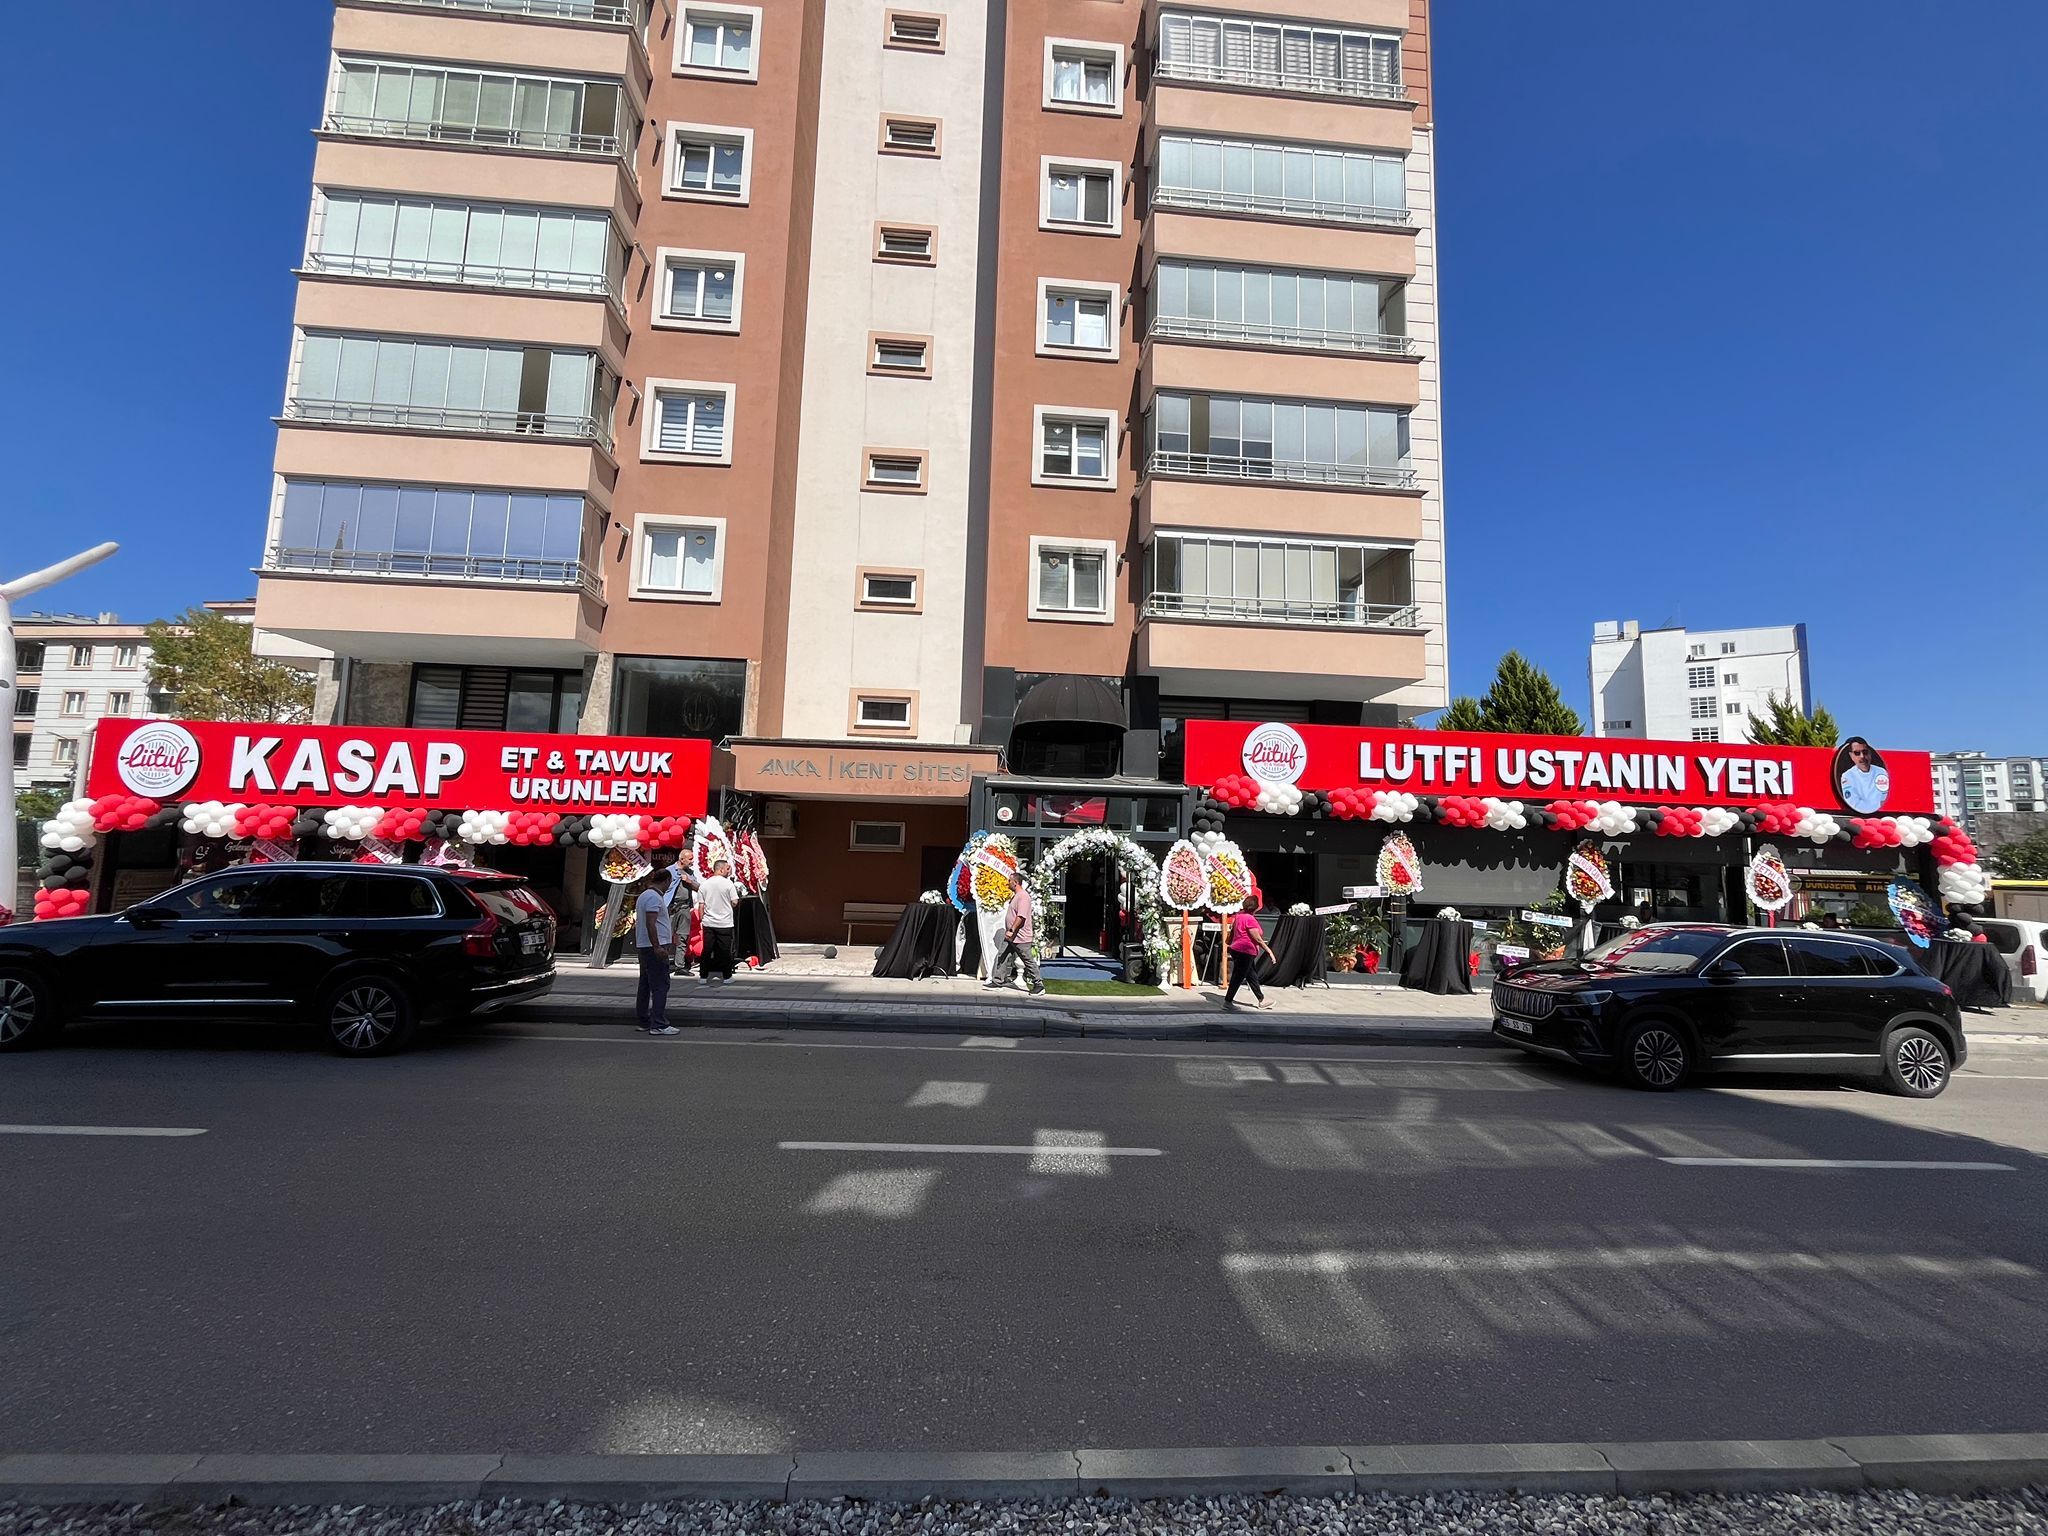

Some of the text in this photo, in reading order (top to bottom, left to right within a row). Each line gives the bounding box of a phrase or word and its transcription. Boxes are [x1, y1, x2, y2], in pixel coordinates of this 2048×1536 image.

[229, 736, 464, 794] KASAP
[501, 747, 672, 773] ET & TAVUK
[757, 758, 821, 777] ANKA
[839, 761, 897, 780] KENT
[1498, 749, 1685, 790] USTANIN
[1698, 756, 1794, 795] YERİ
